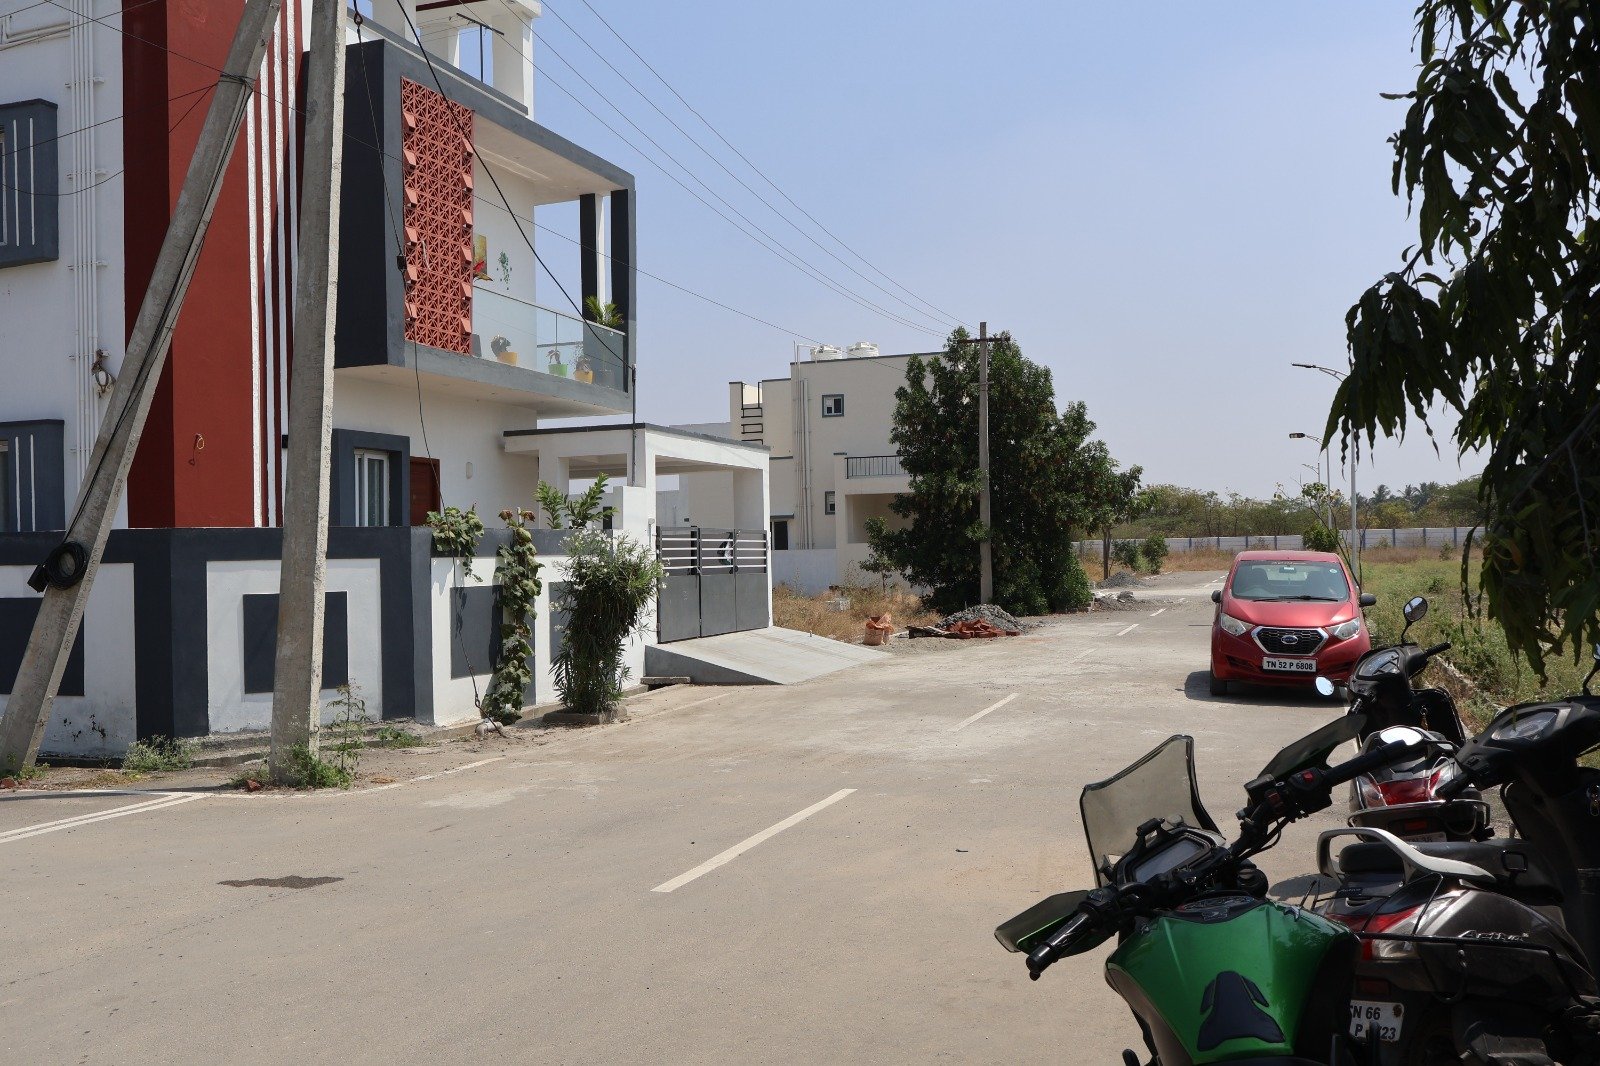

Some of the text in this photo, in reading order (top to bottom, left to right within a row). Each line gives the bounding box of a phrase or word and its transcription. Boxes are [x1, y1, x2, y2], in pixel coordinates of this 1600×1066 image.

[1266, 661, 1277, 669] TN
[1279, 661, 1288, 669] 52
[1296, 663, 1314, 671] 6808
[1350, 1005, 1381, 1020] N 66
[1355, 1023, 1363, 1037] P
